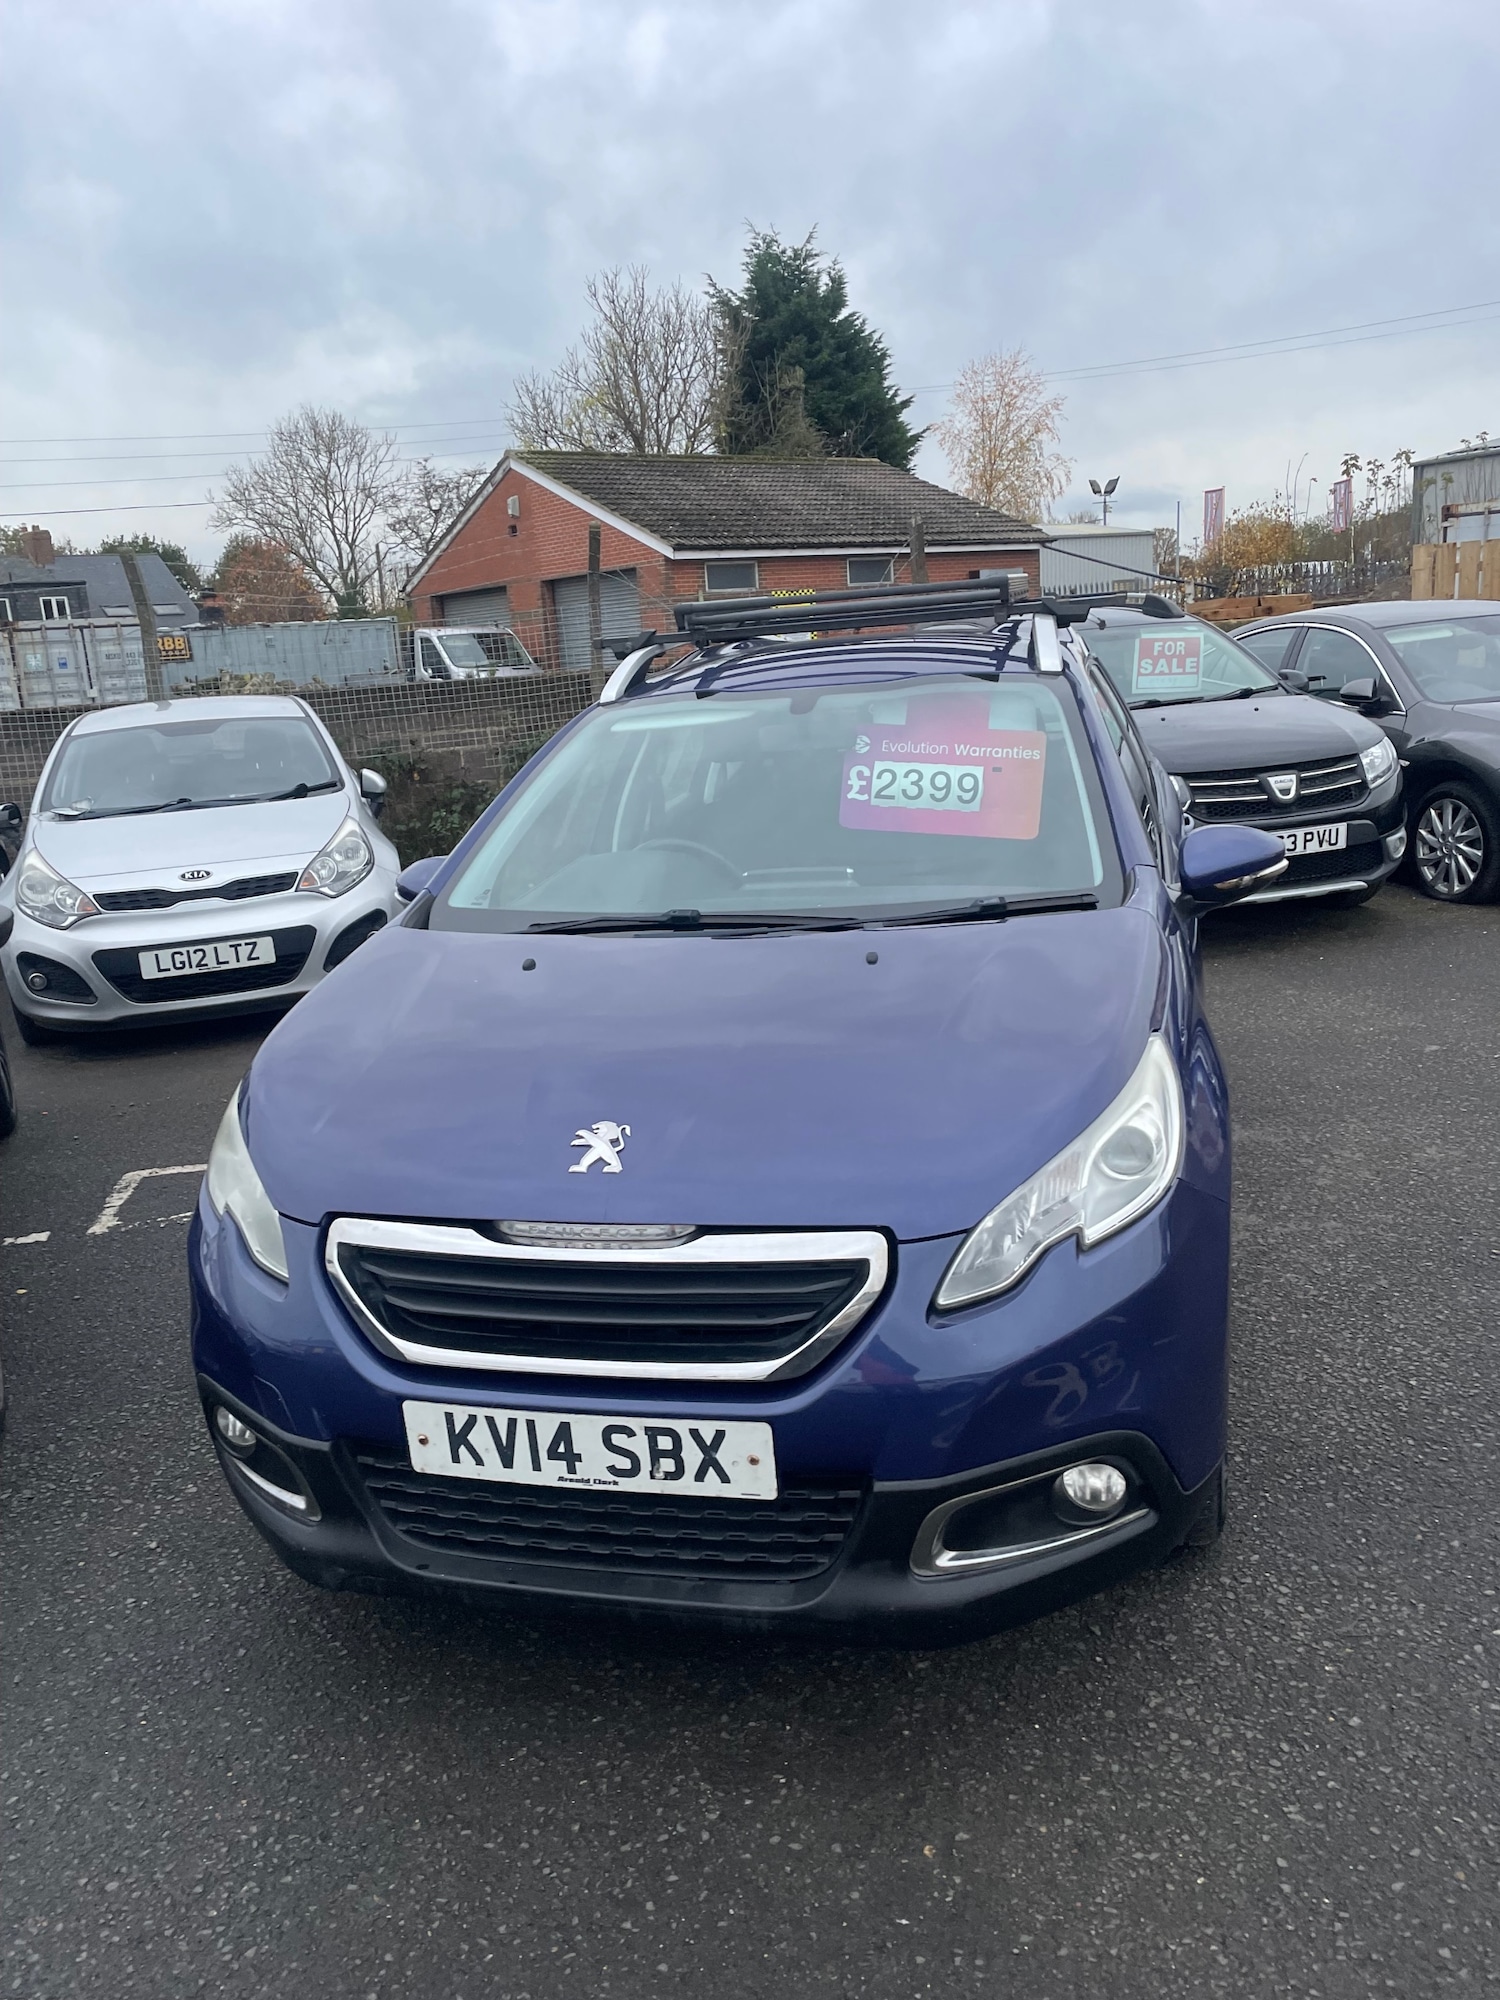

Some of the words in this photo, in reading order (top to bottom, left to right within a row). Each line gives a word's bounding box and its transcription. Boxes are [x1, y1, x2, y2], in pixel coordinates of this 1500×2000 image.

[1153, 641, 1185, 656] FOR
[1140, 657, 1198, 674] SALE
[881, 740, 949, 755] Evolution
[954, 743, 1041, 760] Warranties
[846, 765, 980, 805] £2399
[1276, 833, 1297, 852] 3
[1303, 827, 1339, 850] PVU
[184, 870, 207, 879] KIA
[154, 948, 209, 973] LG12
[213, 941, 260, 965] LTZ
[528, 1225, 649, 1239] PEUGEOT
[444, 1411, 583, 1475] KV14
[601, 1424, 731, 1484] SBX
